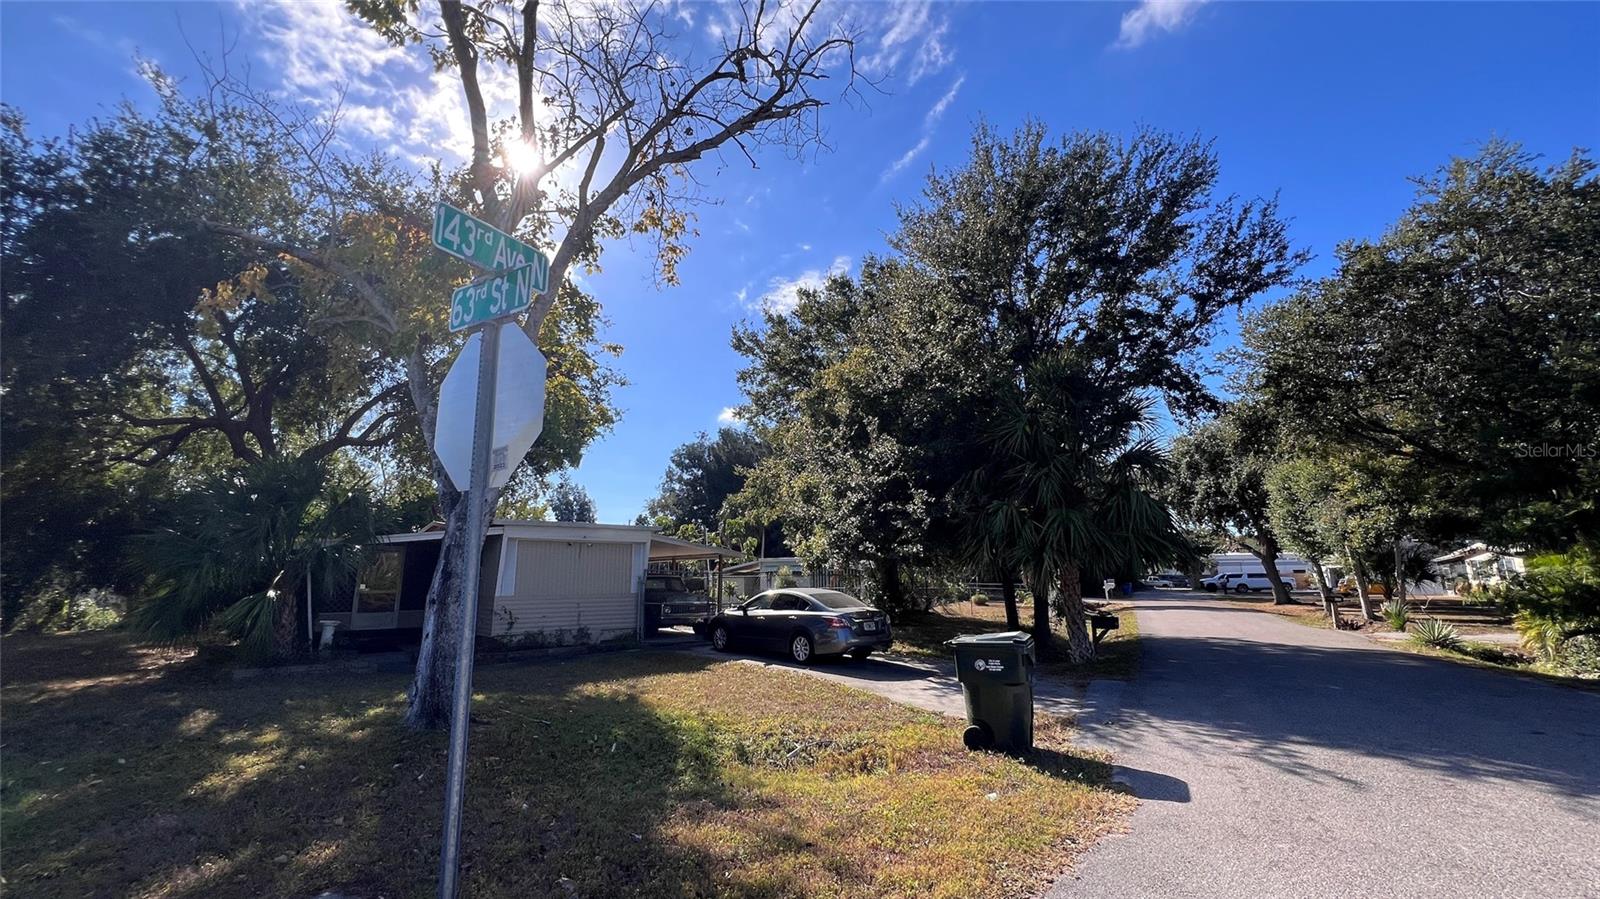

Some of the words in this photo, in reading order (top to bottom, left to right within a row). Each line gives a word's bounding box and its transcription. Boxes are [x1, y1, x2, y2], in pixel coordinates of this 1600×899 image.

[438, 206, 493, 256] 143rd
[493, 237, 525, 270] Ave
[532, 252, 545, 290] N
[453, 284, 487, 326] 63rd
[490, 276, 509, 314] St
[515, 266, 530, 306] N
